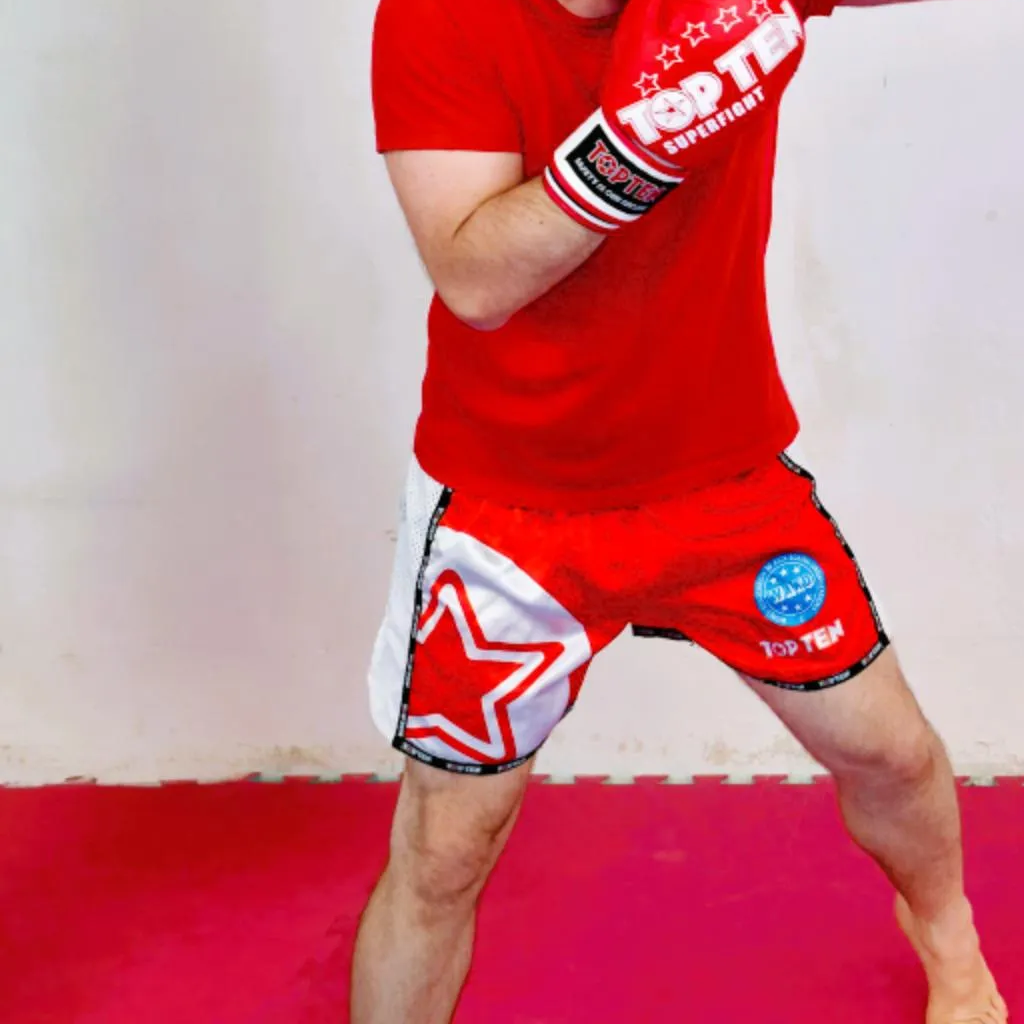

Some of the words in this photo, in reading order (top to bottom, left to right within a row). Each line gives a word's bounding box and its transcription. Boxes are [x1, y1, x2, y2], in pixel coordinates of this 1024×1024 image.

[616, 71, 723, 145] TOP
[662, 85, 766, 155] SUPERFIGHT
[587, 138, 632, 184] TOP
[759, 640, 799, 659] TOP
[799, 618, 846, 653] TEN
